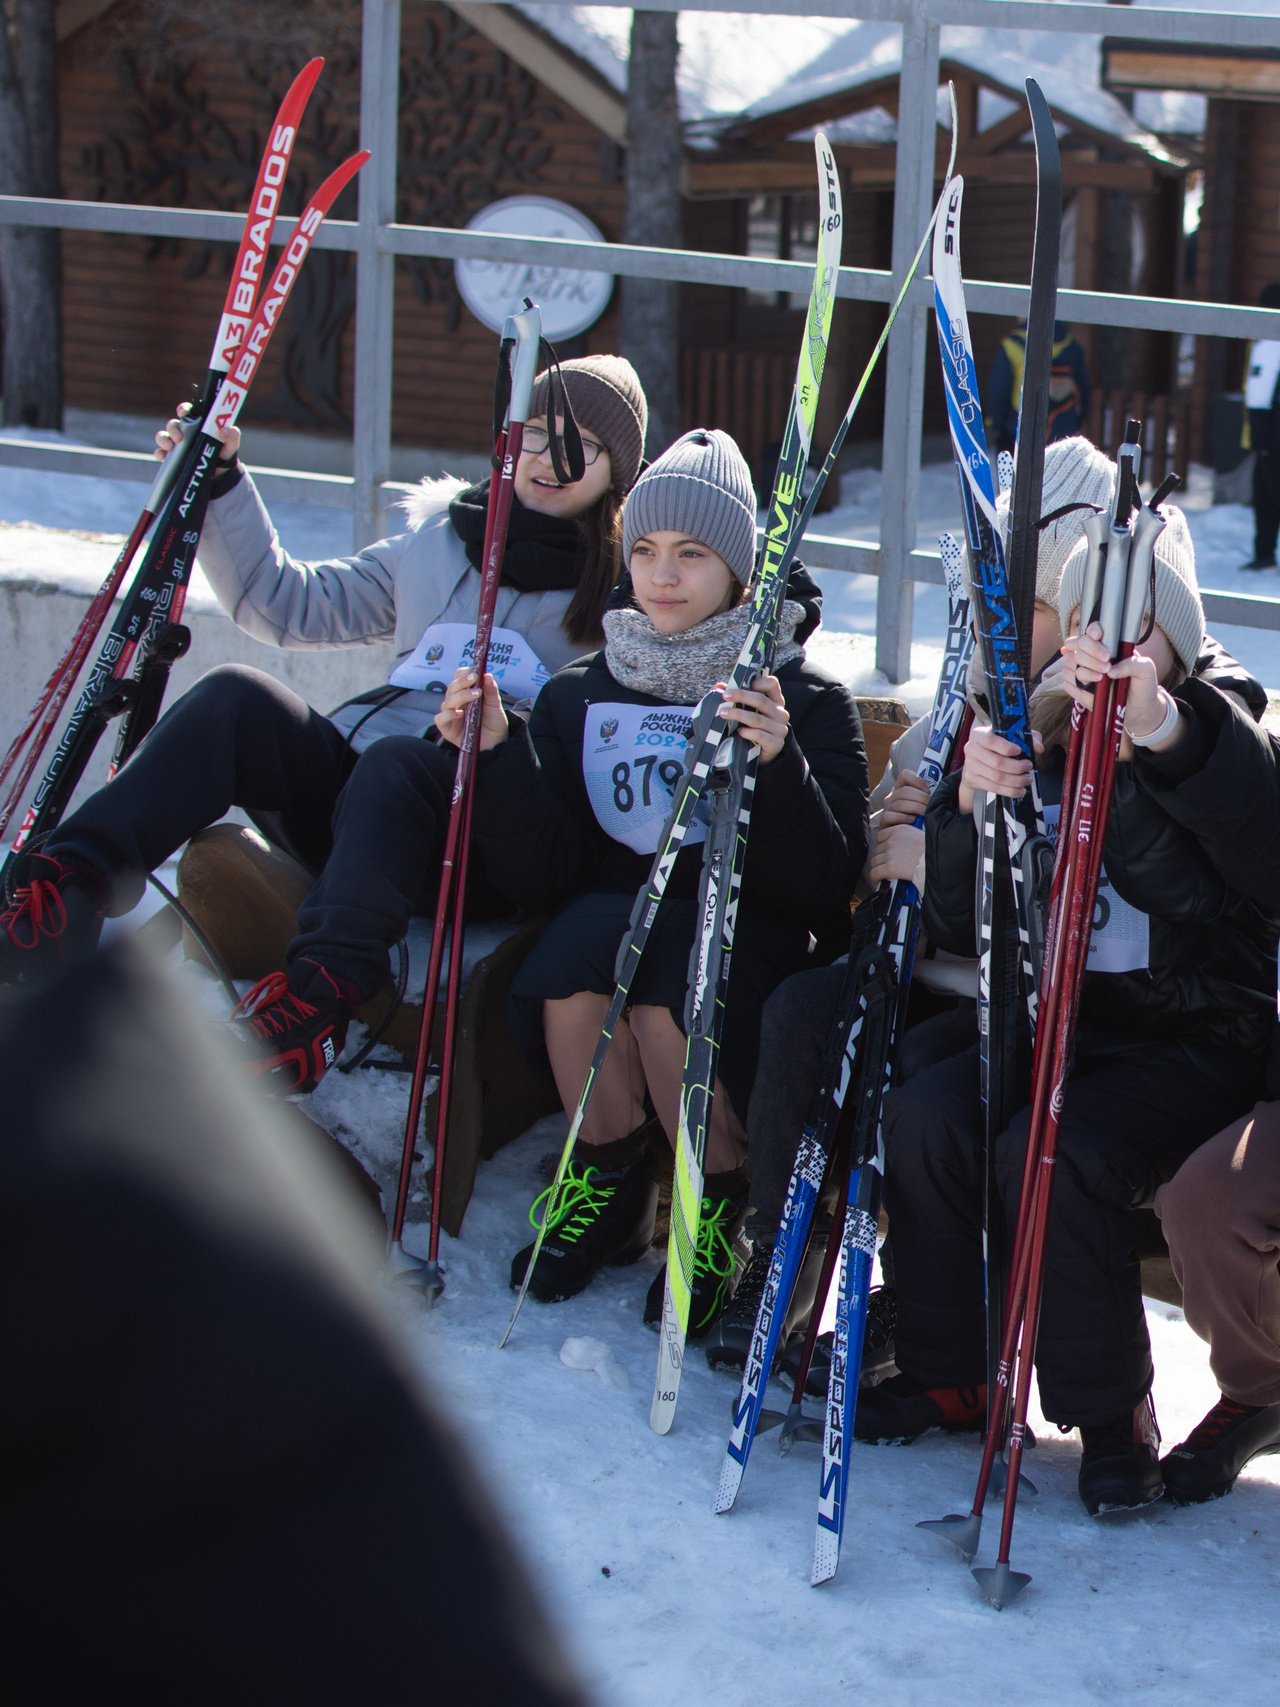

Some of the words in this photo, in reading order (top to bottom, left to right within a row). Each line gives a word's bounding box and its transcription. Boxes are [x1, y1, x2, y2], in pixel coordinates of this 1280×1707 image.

[232, 125, 295, 313] BRADOS
[822, 151, 837, 212] STC
[944, 194, 960, 256] STC
[234, 207, 323, 384] BRADOS
[808, 266, 835, 355] CLASSIC
[221, 322, 246, 366] A3
[950, 318, 976, 425] CLASSIC
[214, 389, 240, 430] A3
[178, 442, 215, 518] ACTIVE
[155, 527, 178, 571] CLASSIC
[980, 563, 1032, 757] ACTIVE
[634, 732, 688, 750] 2024
[322, 1037, 335, 1068] TREK
[728, 1392, 757, 1468] LS
[747, 1259, 784, 1392] SPORT
[780, 1172, 798, 1231] 160
[657, 1390, 676, 1402] 160
[828, 1328, 849, 1457] SPORT
[818, 1456, 841, 1535] LS
